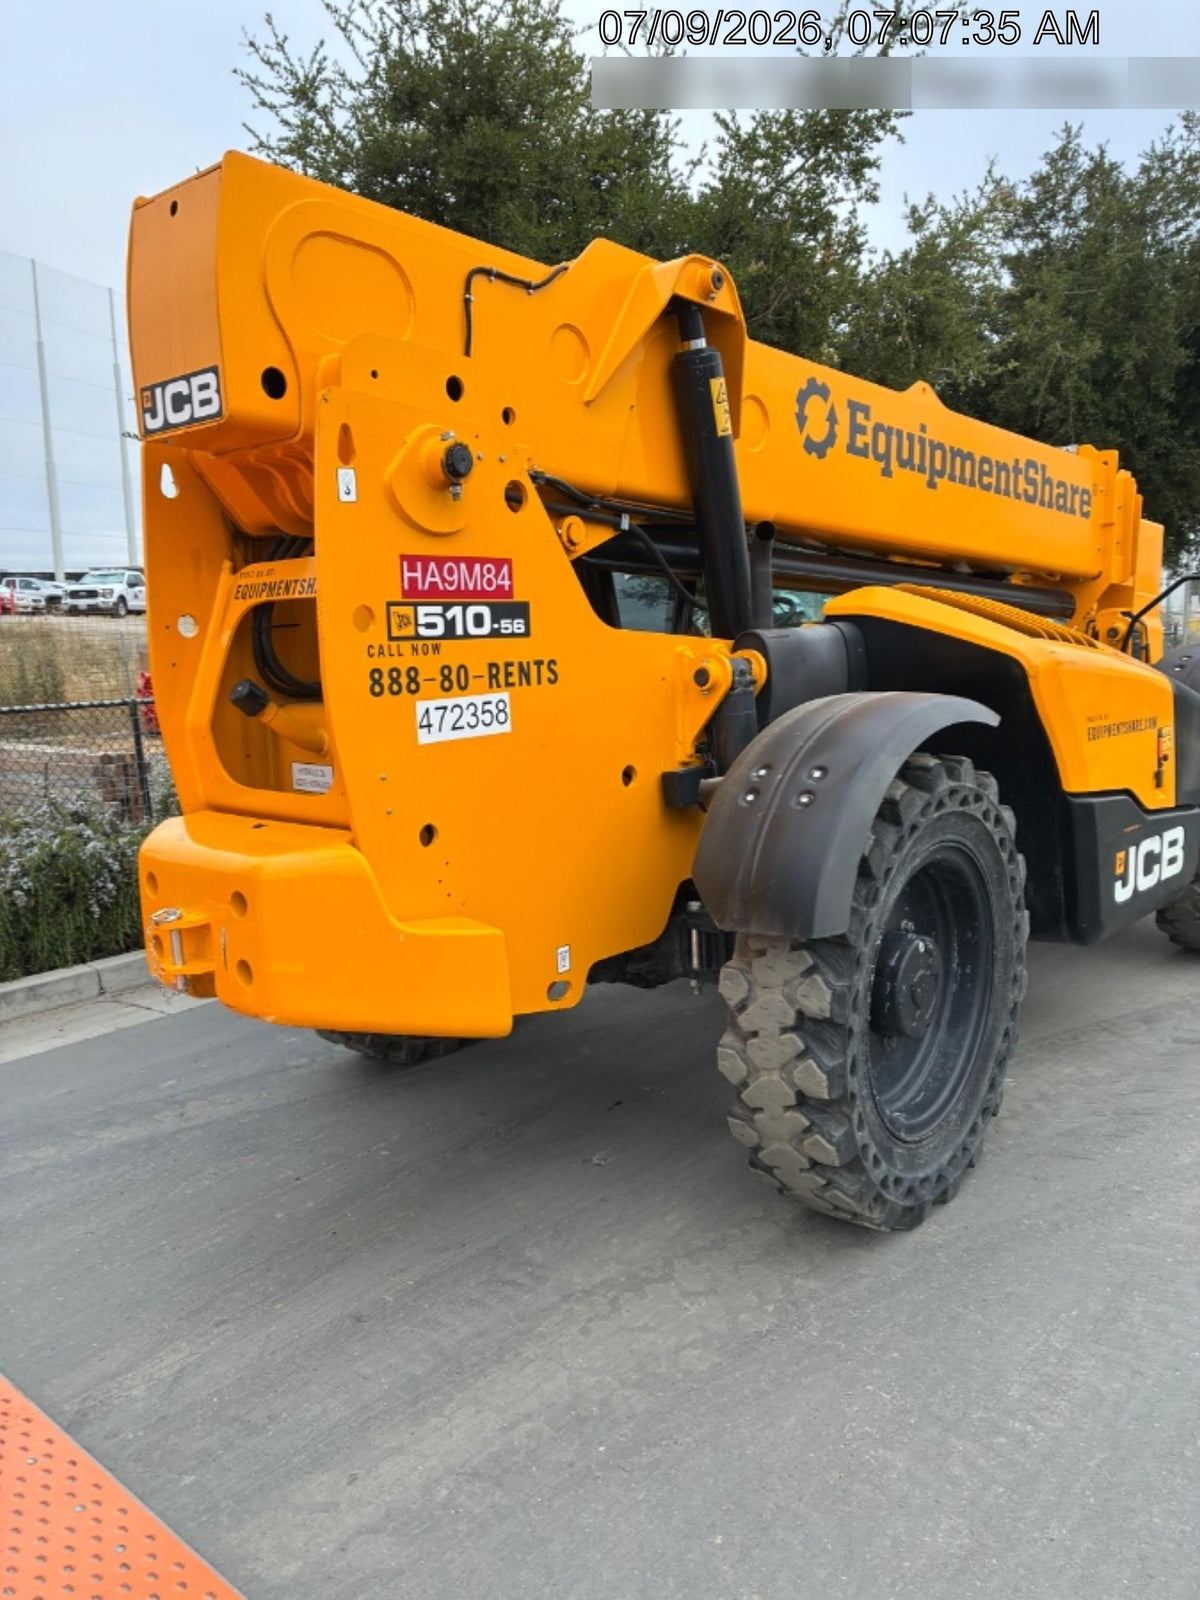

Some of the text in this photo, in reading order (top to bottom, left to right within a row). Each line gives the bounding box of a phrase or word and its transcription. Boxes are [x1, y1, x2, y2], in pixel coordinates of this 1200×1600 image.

[144, 372, 220, 430] JCB
[846, 398, 1091, 519] EquipmentShare
[234, 577, 317, 600] EQUIPMENTSH
[402, 561, 511, 592] HA9M84
[416, 605, 525, 637] 510-56
[367, 642, 441, 658] CALL NOW
[369, 659, 559, 697] 888-80-RENTS
[418, 699, 508, 735] 472358
[1114, 826, 1184, 903] JCB
